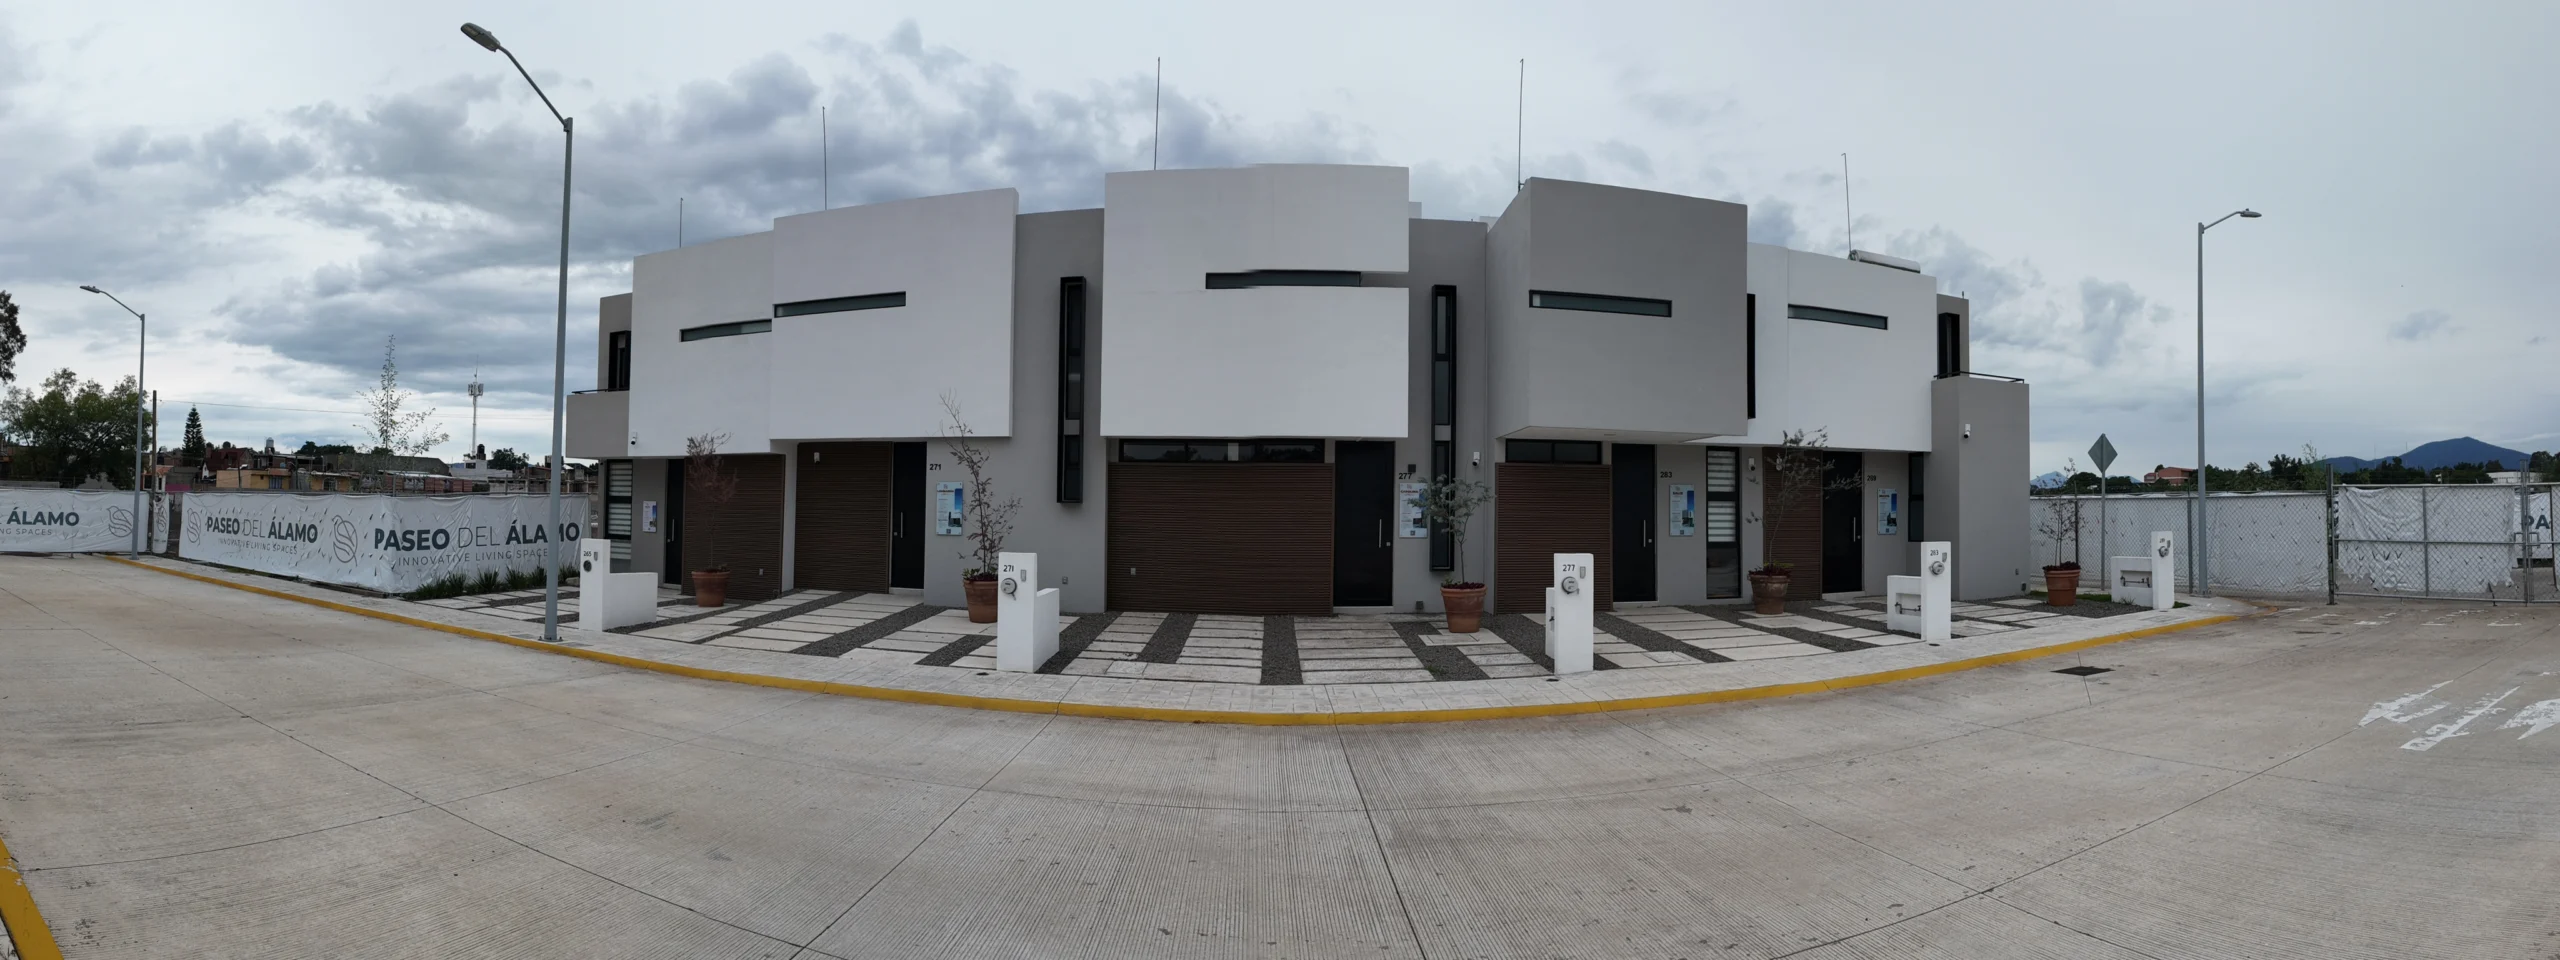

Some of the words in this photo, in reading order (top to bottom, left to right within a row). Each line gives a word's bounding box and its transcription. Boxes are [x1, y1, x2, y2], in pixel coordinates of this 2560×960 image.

[929, 463, 942, 471] 271
[1398, 472, 1413, 480] 277
[6, 506, 80, 527] ÁLAMO
[15, 528, 53, 536] SPACES
[206, 516, 241, 536] PASEO
[243, 518, 266, 538] DEL
[267, 516, 319, 543] ÁLAMO
[374, 528, 450, 552] PASEO
[458, 525, 501, 549] DEL
[505, 519, 580, 546] ÁLAO
[218, 537, 250, 549] INNOVATIVE
[250, 542, 271, 551] LIVING
[272, 543, 298, 554] SPACES
[398, 551, 471, 567] INNOVATIVE
[475, 550, 513, 562] LIVING
[516, 548, 549, 559] SPACE
[1003, 564, 1015, 573] 271
[1562, 563, 1576, 572] 277
